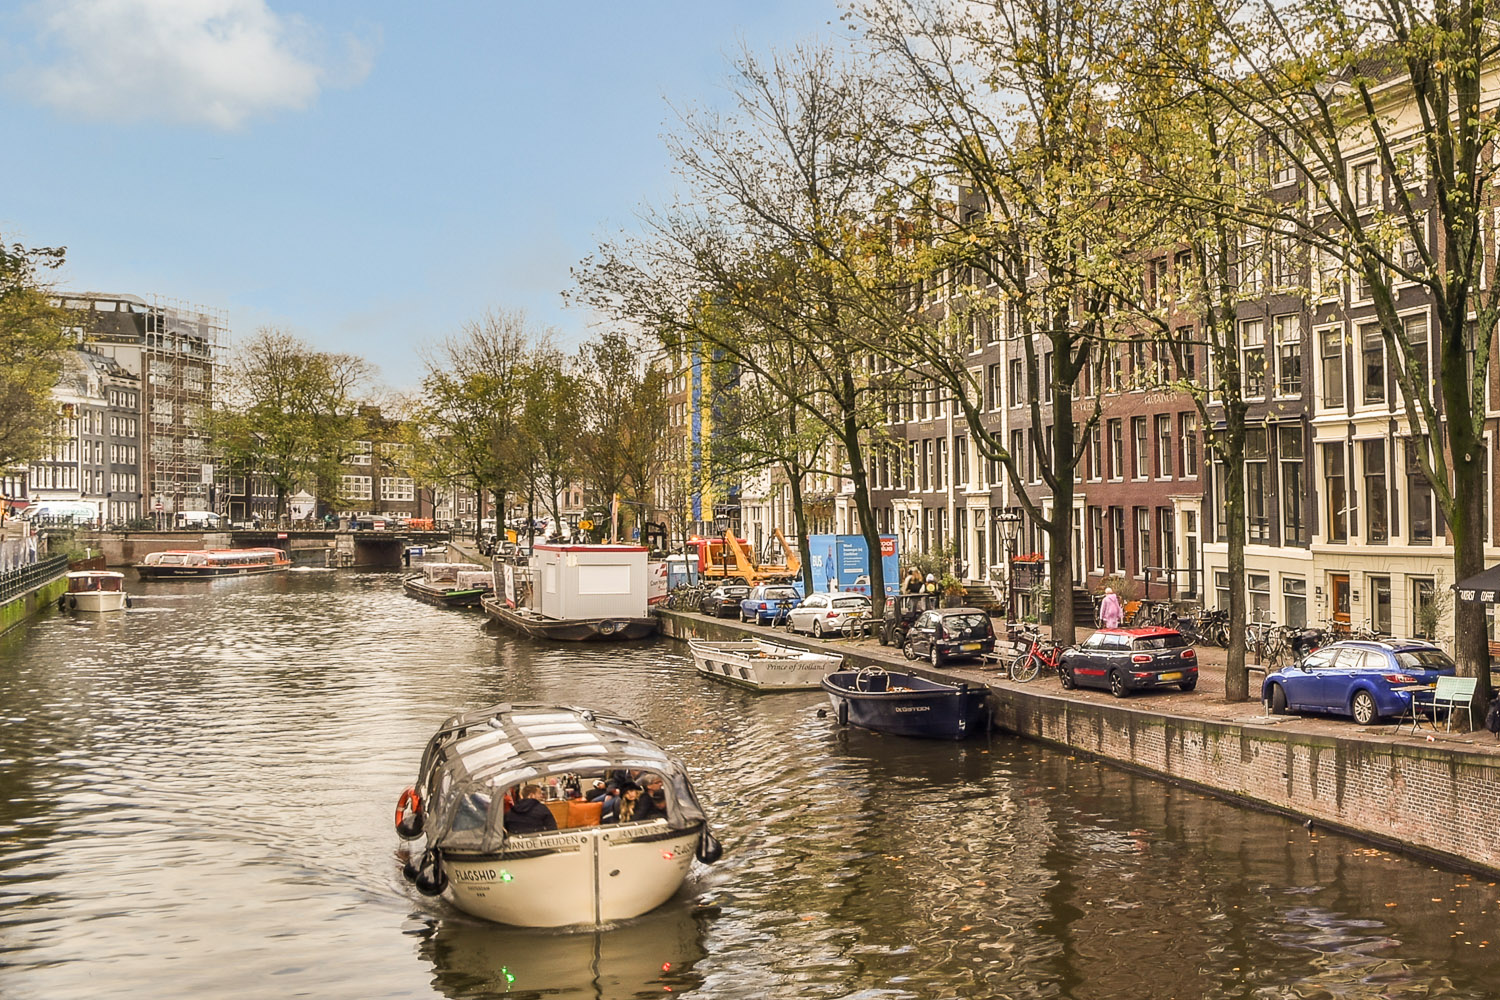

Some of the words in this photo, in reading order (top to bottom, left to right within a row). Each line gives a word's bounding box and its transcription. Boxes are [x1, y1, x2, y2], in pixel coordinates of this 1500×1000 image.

[1480, 591, 1496, 602] COFFEE
[766, 663, 788, 671] Prince
[788, 663, 797, 672] of
[797, 663, 826, 671] Holland
[455, 869, 497, 881] FLAGSHIP
